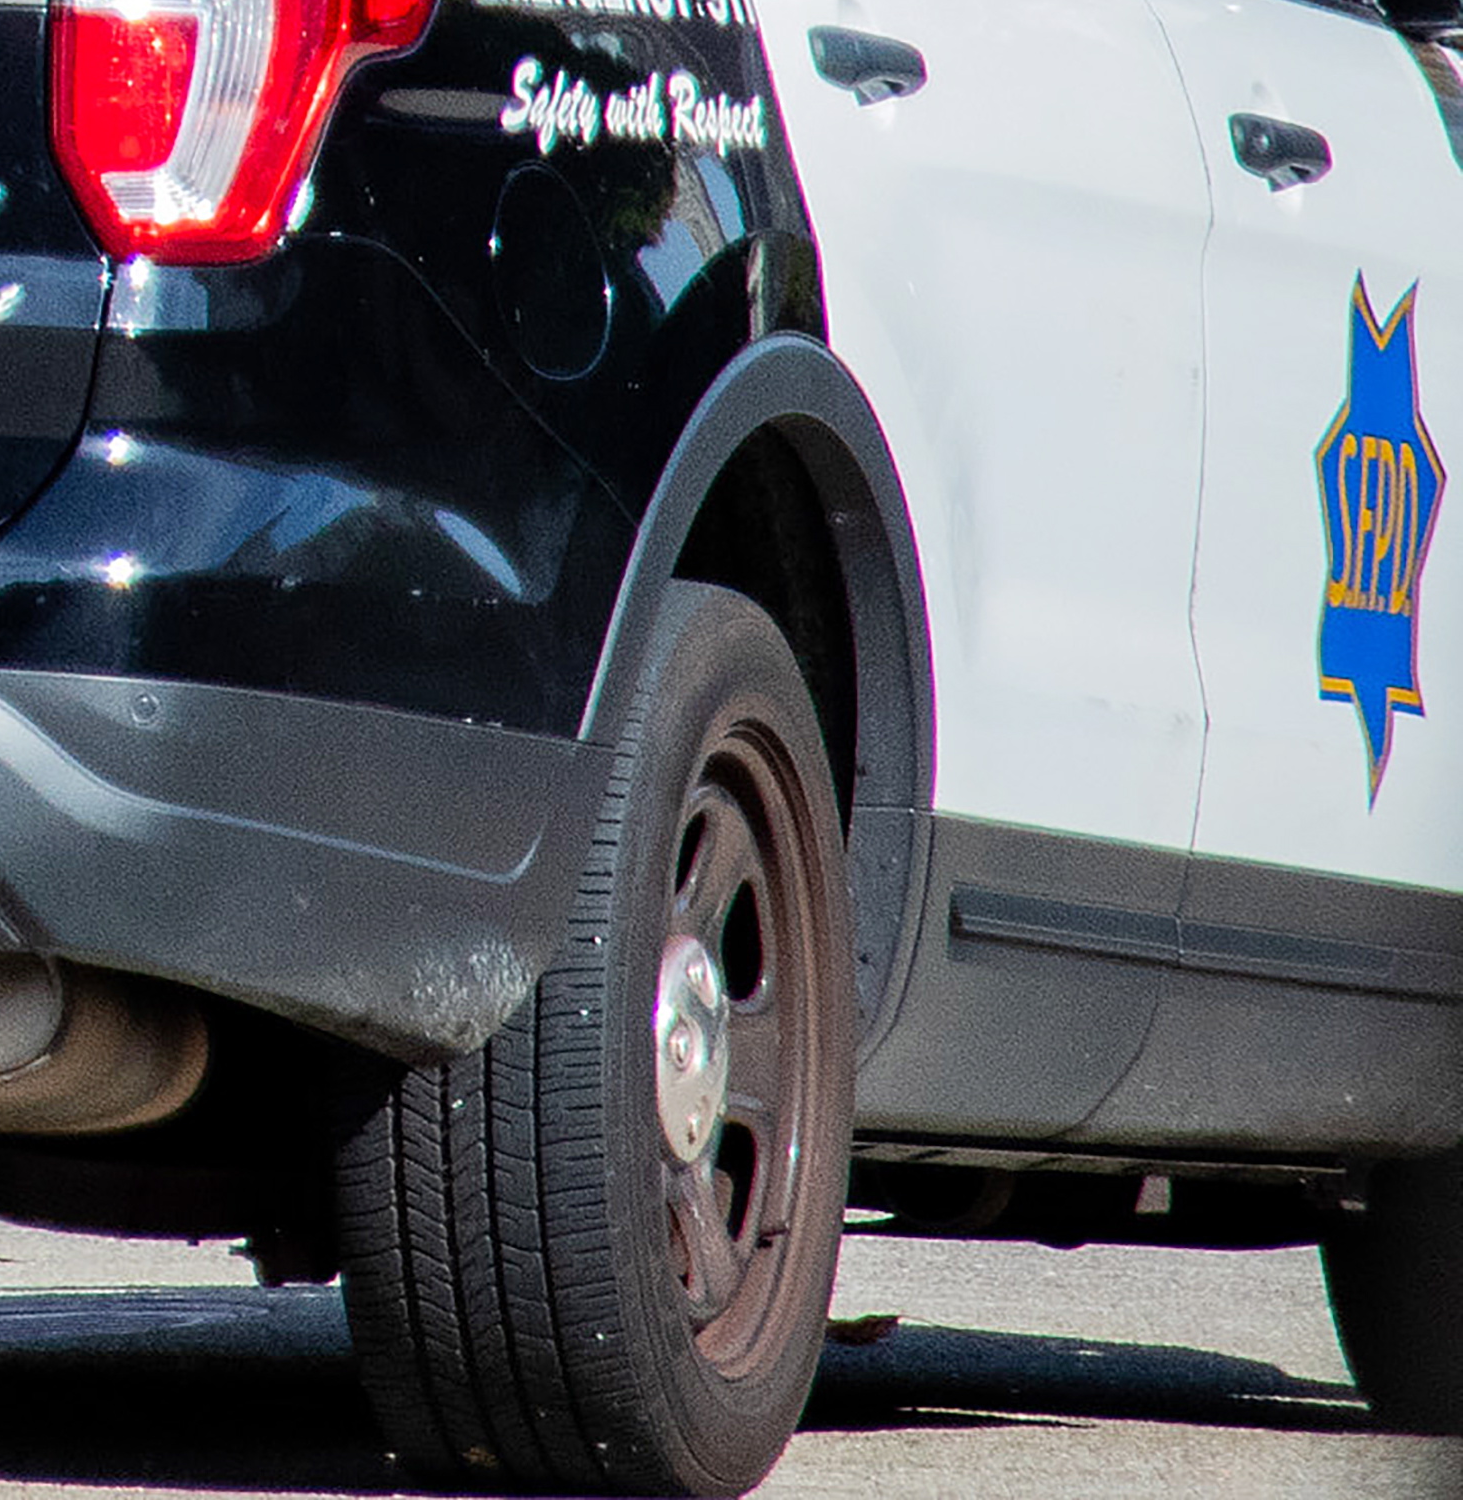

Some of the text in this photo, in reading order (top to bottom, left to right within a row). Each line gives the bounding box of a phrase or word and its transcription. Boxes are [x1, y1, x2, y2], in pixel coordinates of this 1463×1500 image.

[500, 56, 769, 158] Safety with Respect
